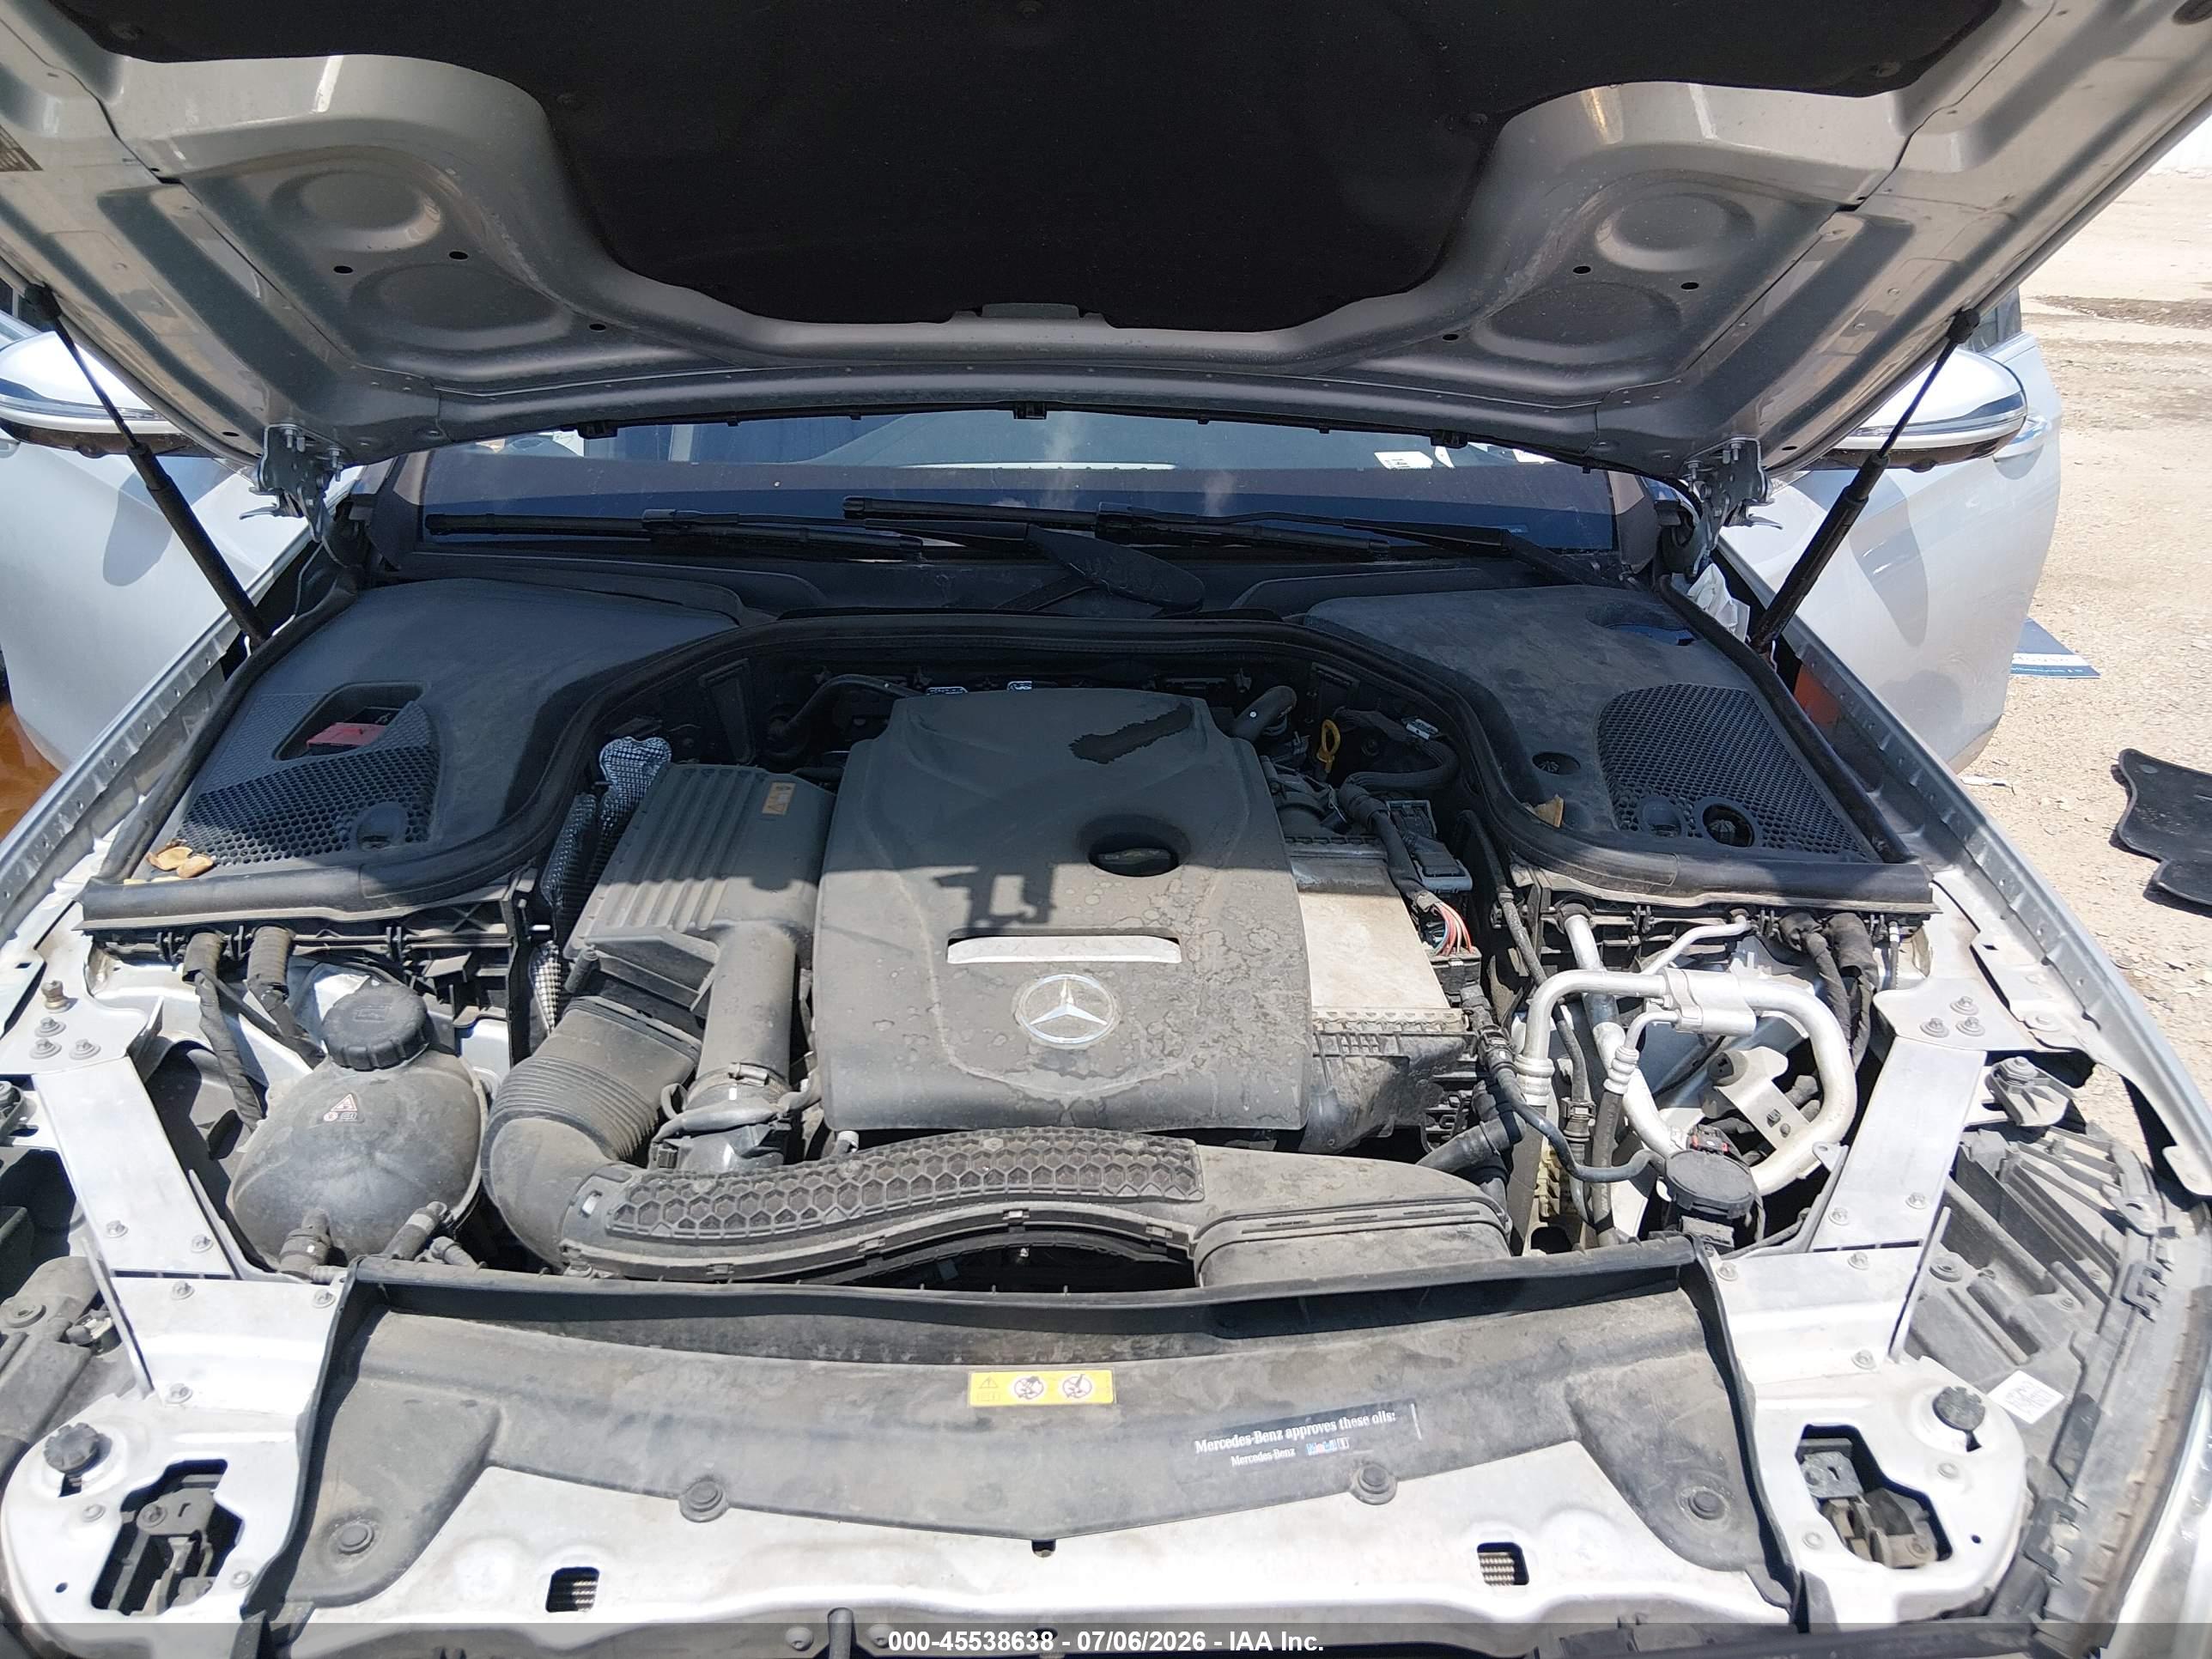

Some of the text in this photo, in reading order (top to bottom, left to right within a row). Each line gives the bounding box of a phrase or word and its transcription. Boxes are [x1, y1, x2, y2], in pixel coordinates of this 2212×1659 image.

[1194, 1410, 1395, 1454] Mercedes-Benz approves these oils:
[1231, 1447, 1296, 1467] Mercedes-Benz
